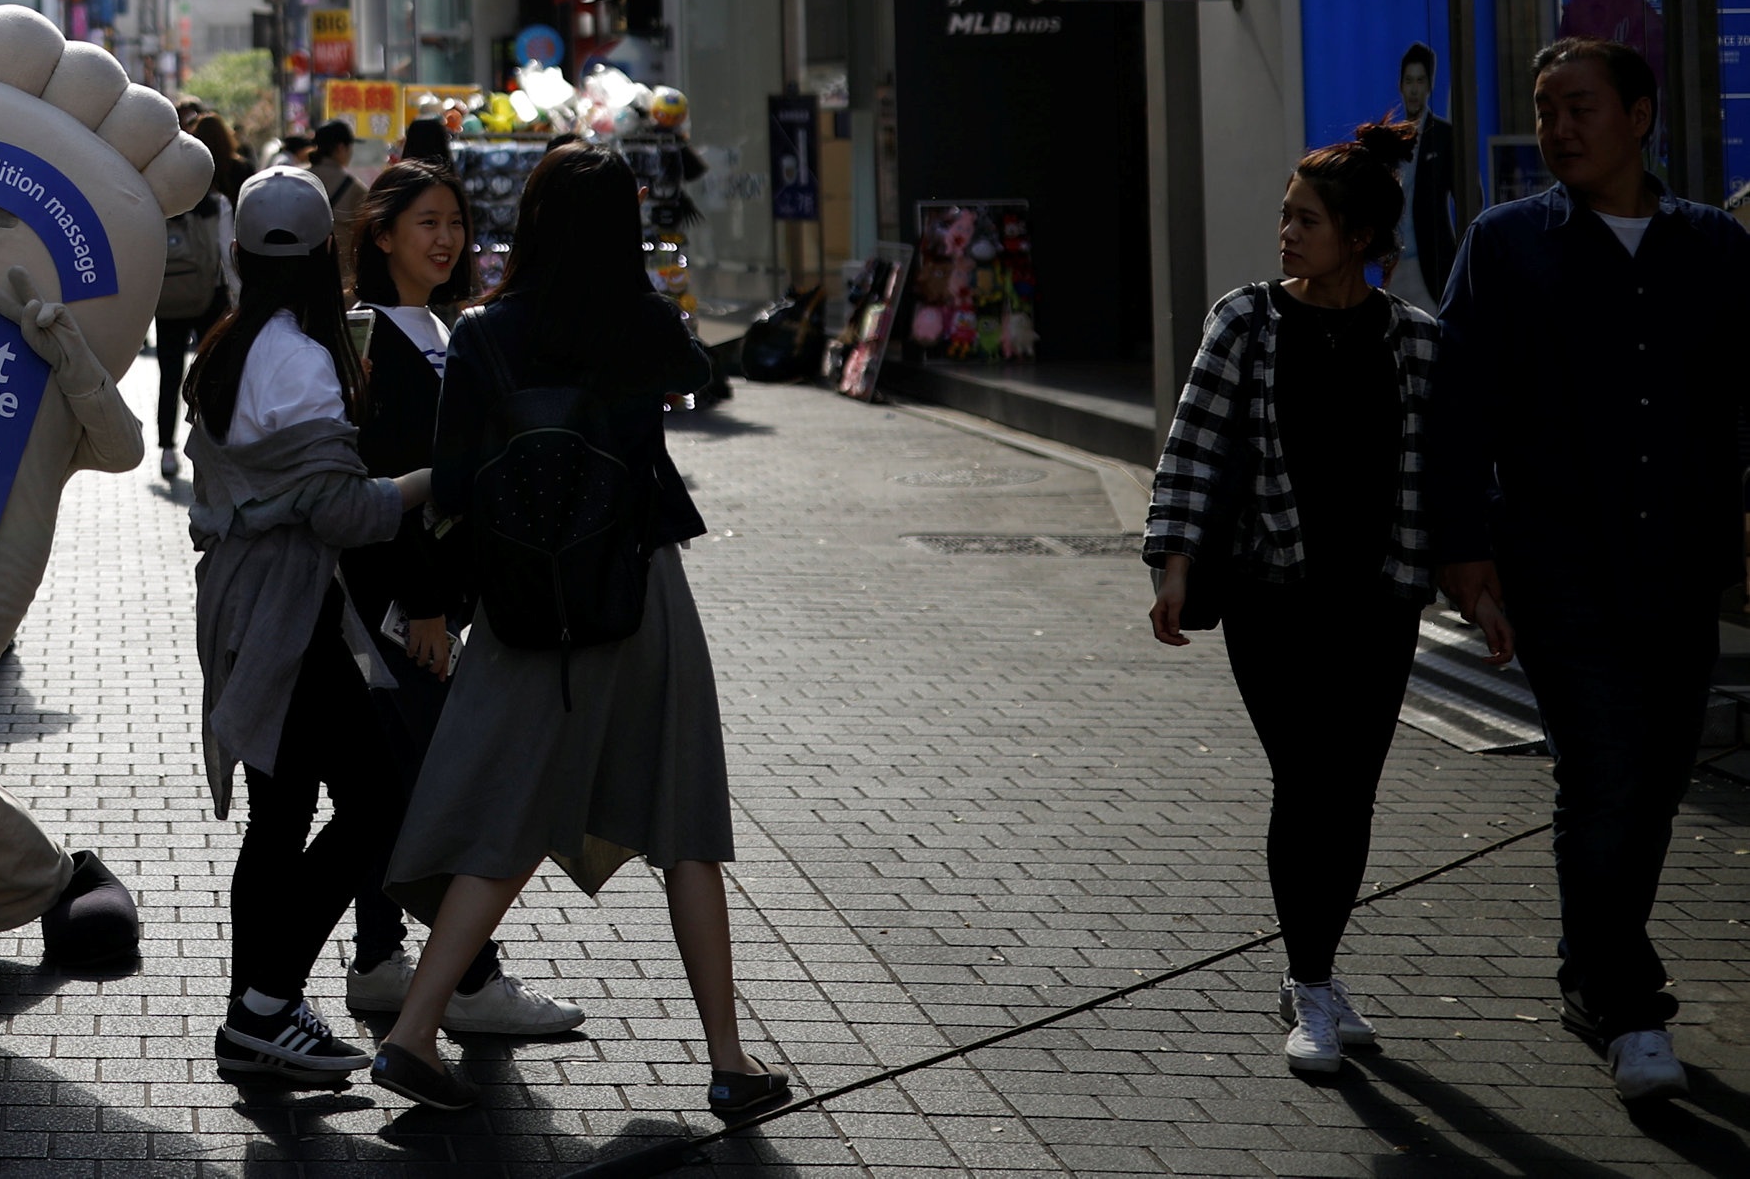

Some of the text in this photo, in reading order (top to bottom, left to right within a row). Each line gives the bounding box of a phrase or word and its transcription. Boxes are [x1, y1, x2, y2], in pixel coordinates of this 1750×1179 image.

[315, 12, 348, 33] BIG
[948, 11, 1063, 35] MLB KIDS
[43, 196, 97, 285] massage
